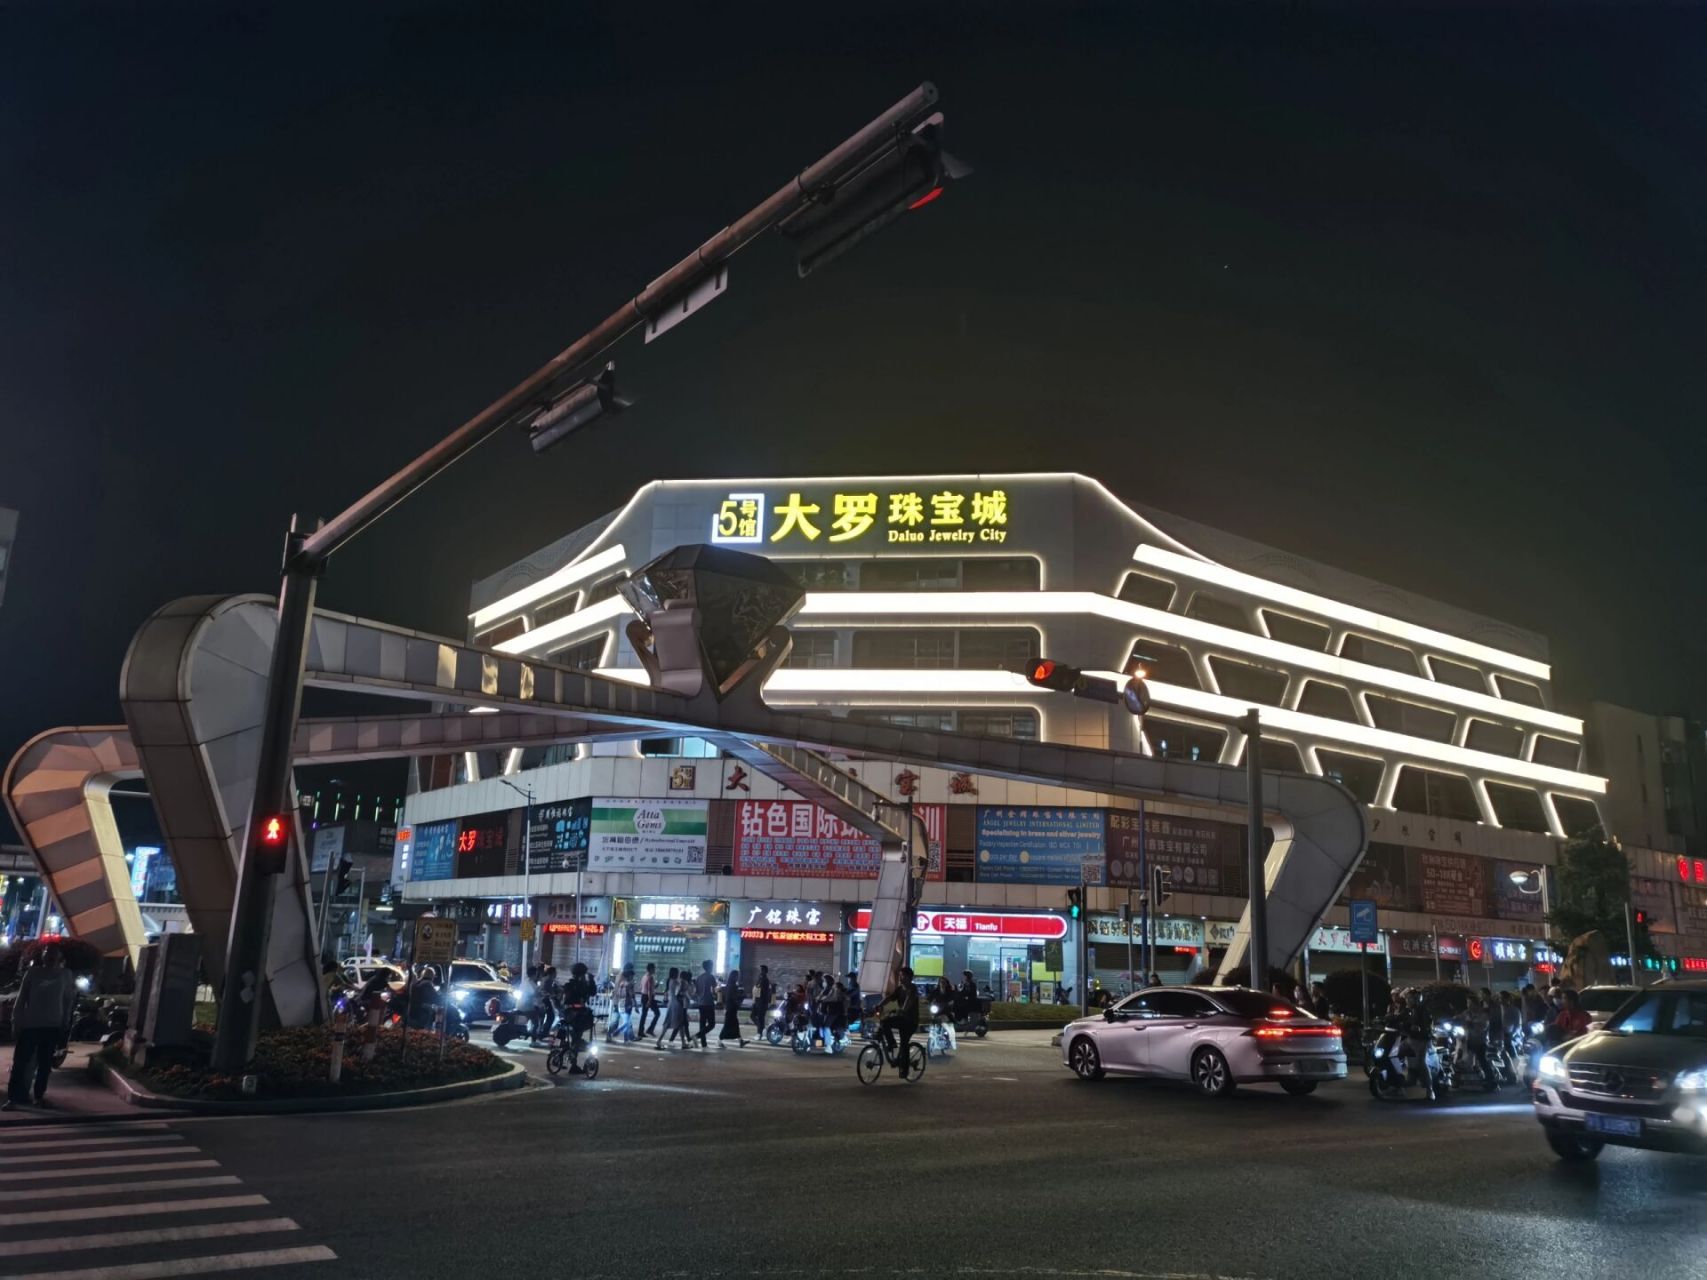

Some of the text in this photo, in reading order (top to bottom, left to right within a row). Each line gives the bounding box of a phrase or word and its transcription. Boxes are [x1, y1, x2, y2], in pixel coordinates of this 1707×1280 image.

[888, 528, 1007, 543] Daluo Jewelry City
[637, 809, 660, 819] Atta
[637, 819, 662, 829] Gems
[747, 906, 822, 926] 广铭珠宝
[943, 916, 998, 932] 天福 Tianfu
